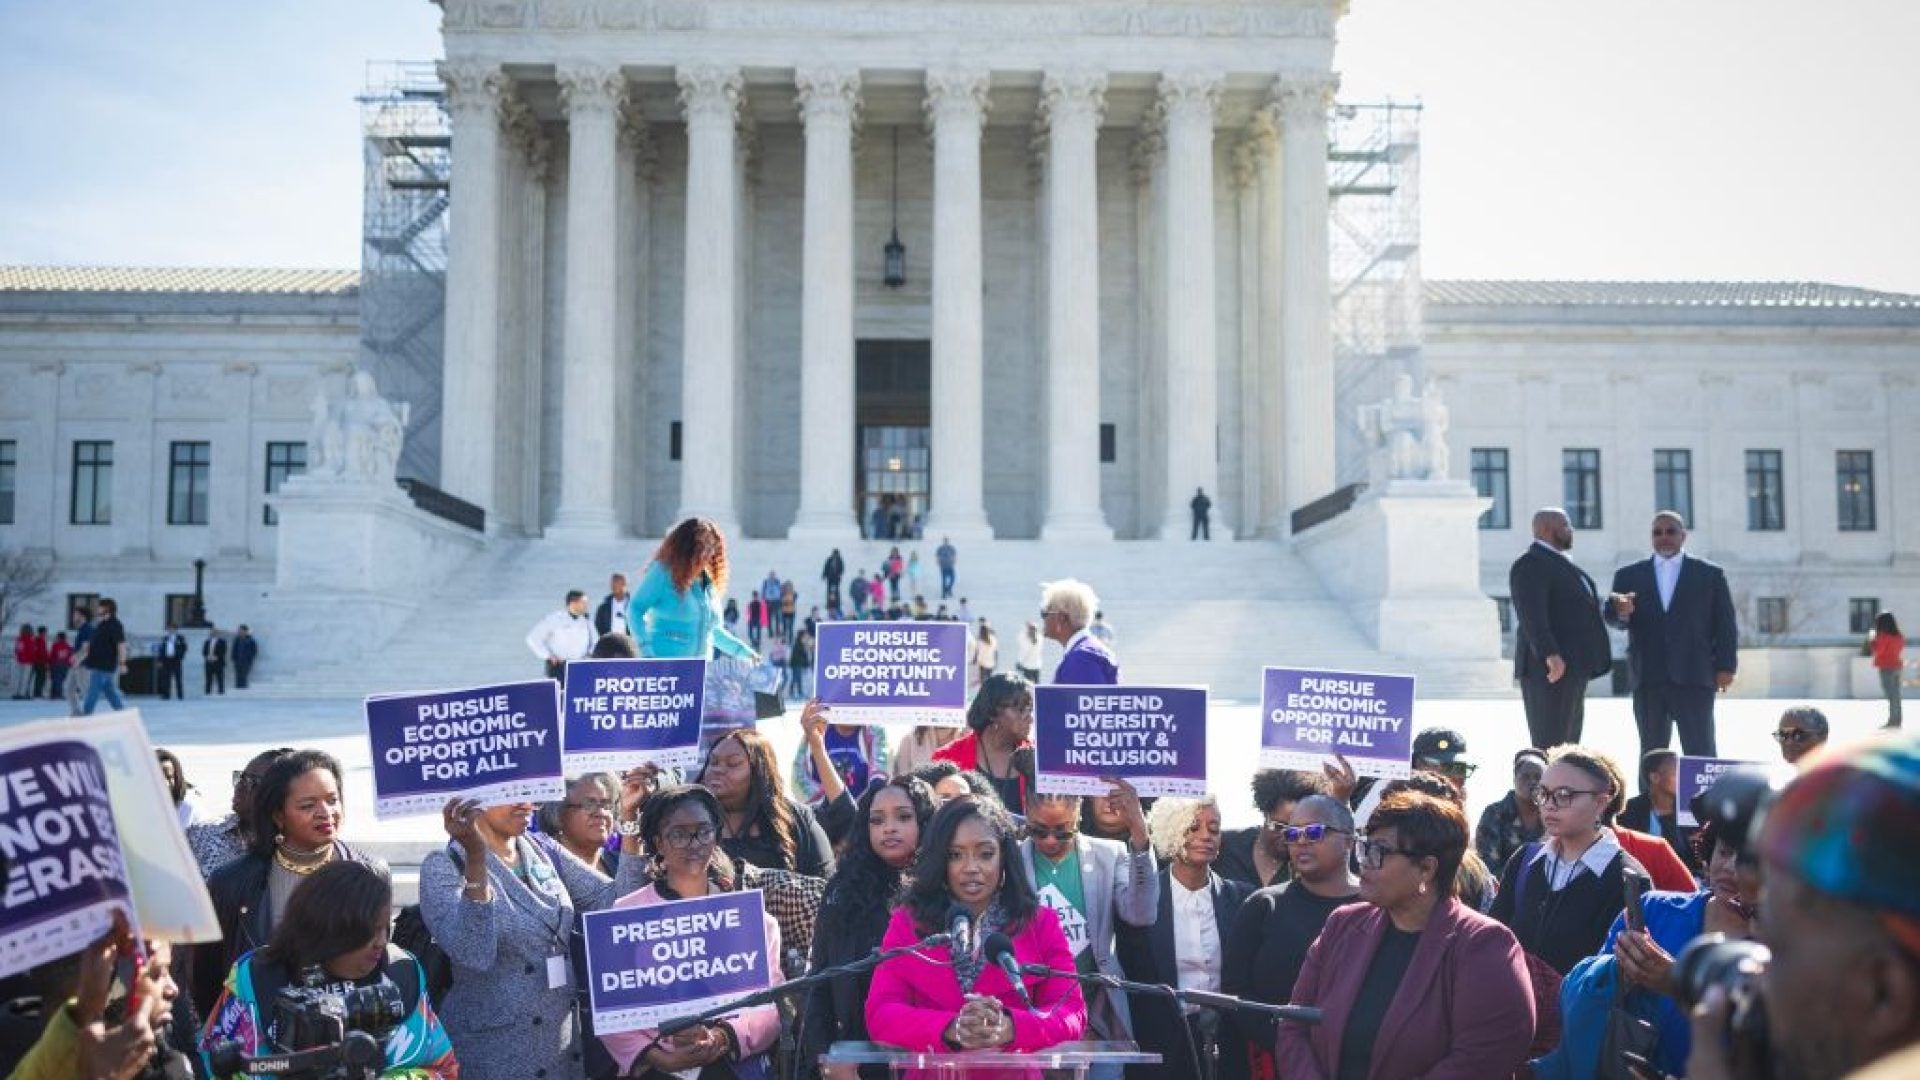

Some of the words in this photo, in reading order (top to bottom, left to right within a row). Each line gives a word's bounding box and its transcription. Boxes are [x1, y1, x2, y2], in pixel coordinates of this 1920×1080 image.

[854, 631, 929, 646] PURSUE
[840, 648, 942, 663] ECONOMIC
[824, 664, 957, 680] OPPORTUNITY
[594, 676, 680, 694] PROTECT
[850, 681, 890, 696] FOR
[893, 681, 931, 696] ALL
[1300, 677, 1376, 697] PURSUE
[417, 694, 509, 723] PURSUE
[573, 696, 609, 713] THE
[612, 693, 695, 711] FREEDOM
[1077, 695, 1164, 711] DEFEND
[1287, 693, 1388, 714] ECONOMIC
[403, 712, 527, 743] ECONOMIC
[590, 713, 616, 730] TO
[620, 711, 680, 729] LEARN
[1064, 713, 1177, 732] DIVERSITY,
[1271, 708, 1404, 733] OPPORTUNITY
[1073, 731, 1151, 747] EQUITY
[1154, 732, 1169, 747] &
[1295, 726, 1334, 744] FOR
[1336, 730, 1375, 747] ALL
[385, 729, 549, 765] OPPORTUNITY
[421, 760, 470, 781] FOR
[475, 753, 519, 774] ALL
[1064, 749, 1178, 766] INCLUSION
[0, 803, 90, 858] NOT
[3, 845, 124, 908] ERAS
[611, 908, 741, 944] PRESERVE
[652, 937, 707, 962] OUR
[601, 951, 759, 992] DEMOCRACY
[249, 1058, 290, 1073] RONIN
